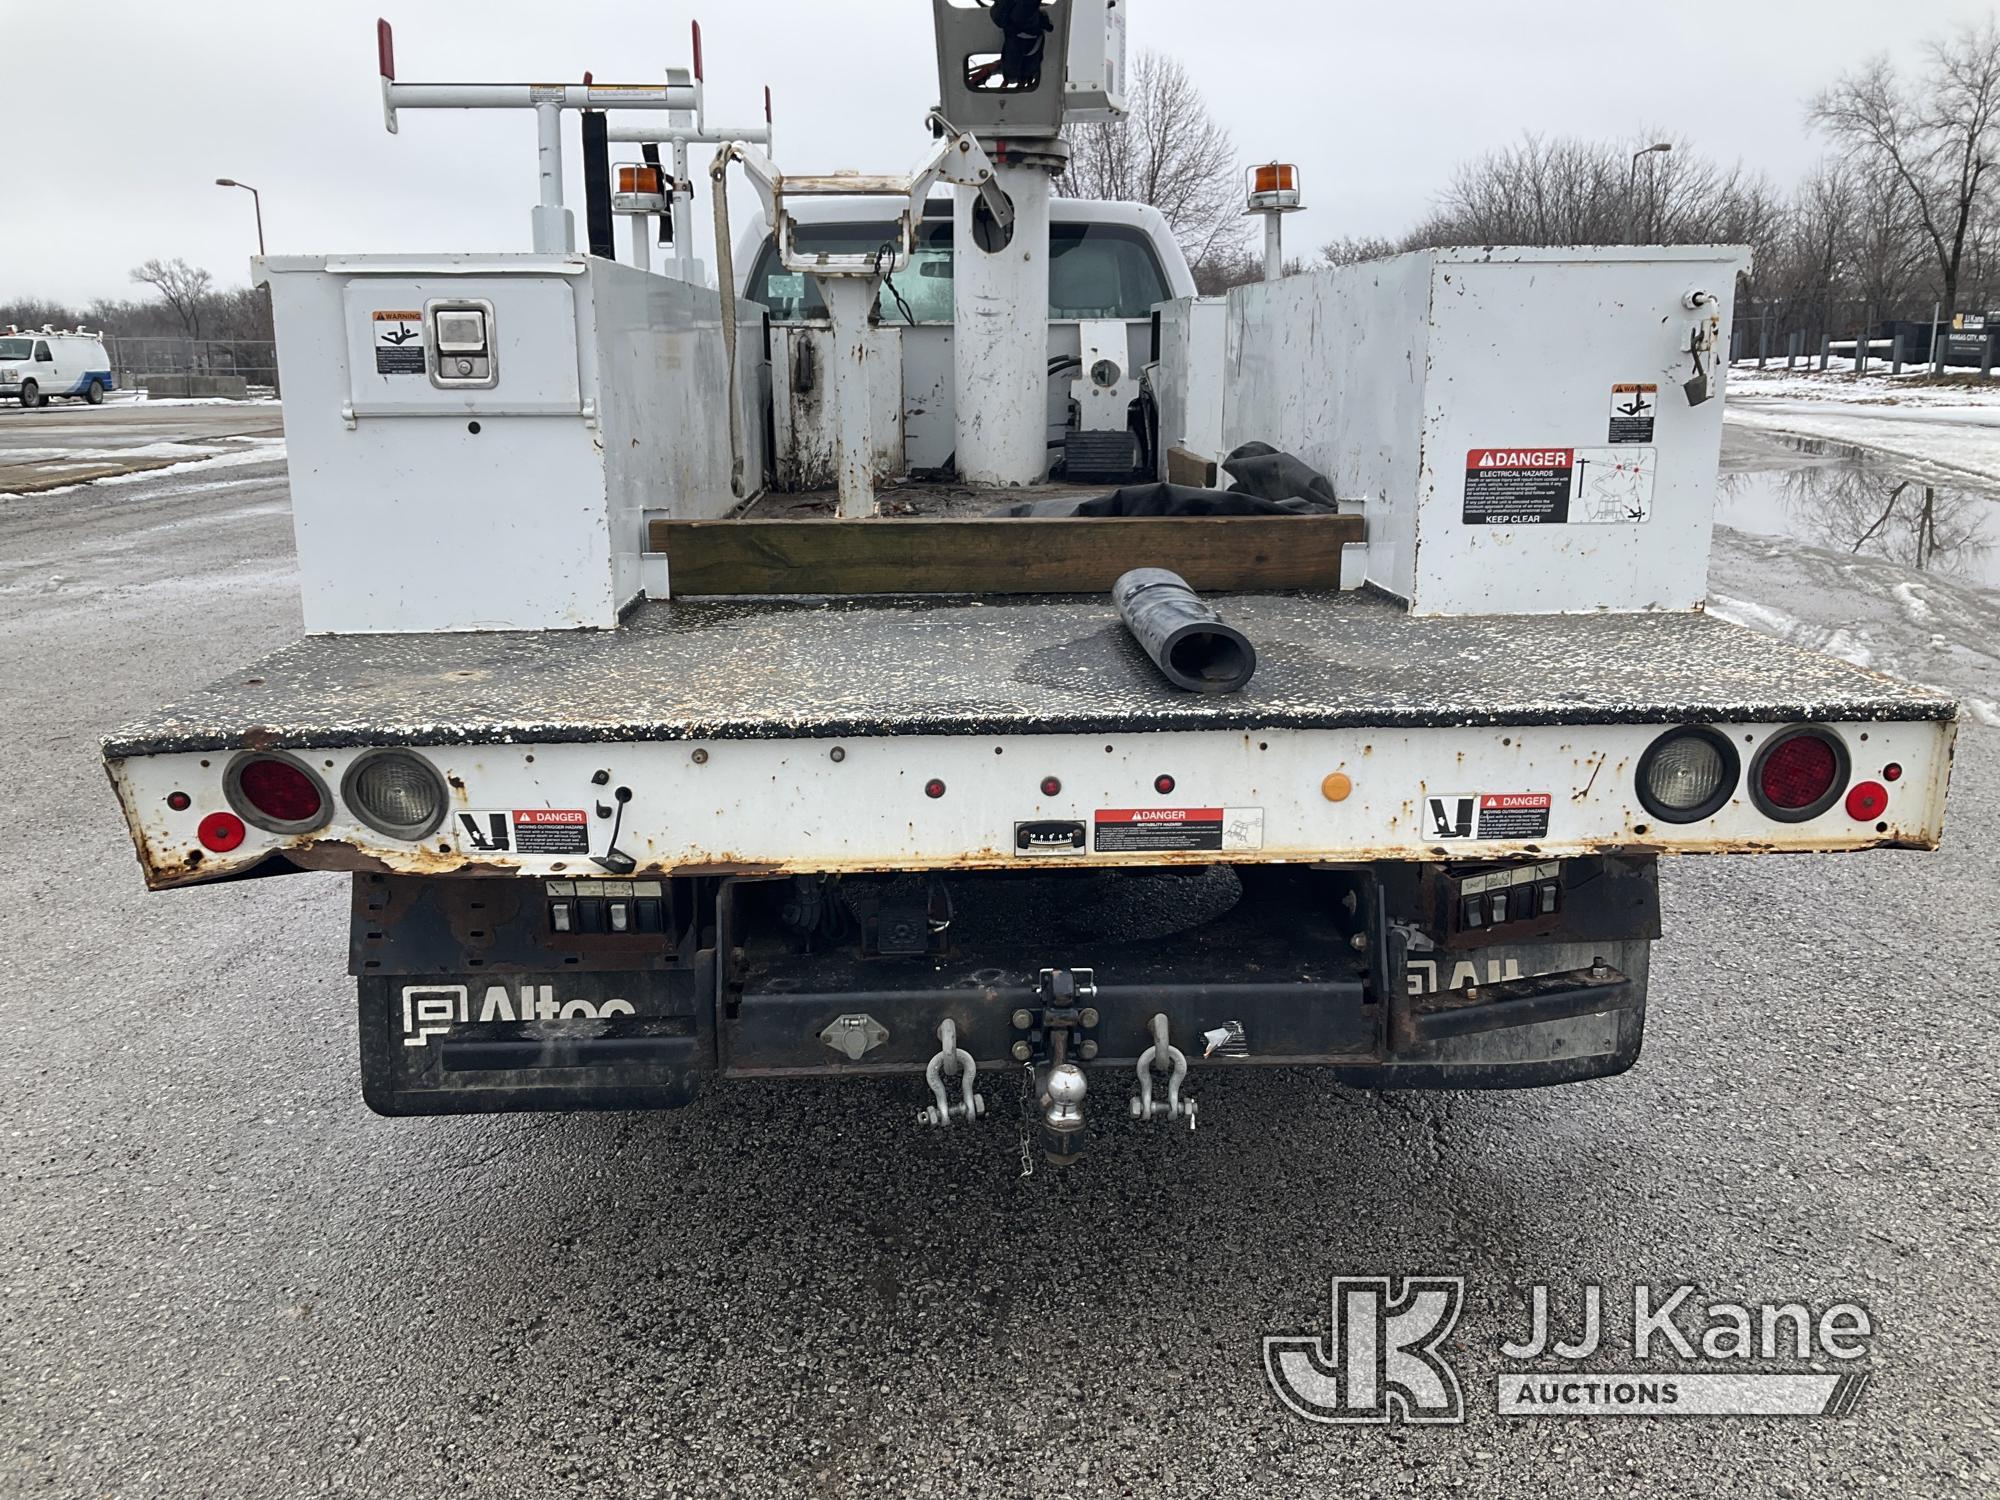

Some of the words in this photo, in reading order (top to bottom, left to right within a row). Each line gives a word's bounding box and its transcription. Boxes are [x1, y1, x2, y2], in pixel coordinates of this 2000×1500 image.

[1495, 452, 1566, 466] DANGER
[1511, 515, 1540, 523] CLEAR
[1503, 796, 1547, 806] DANGER
[537, 813, 582, 821] DANGER
[1142, 811, 1186, 820] DANGER
